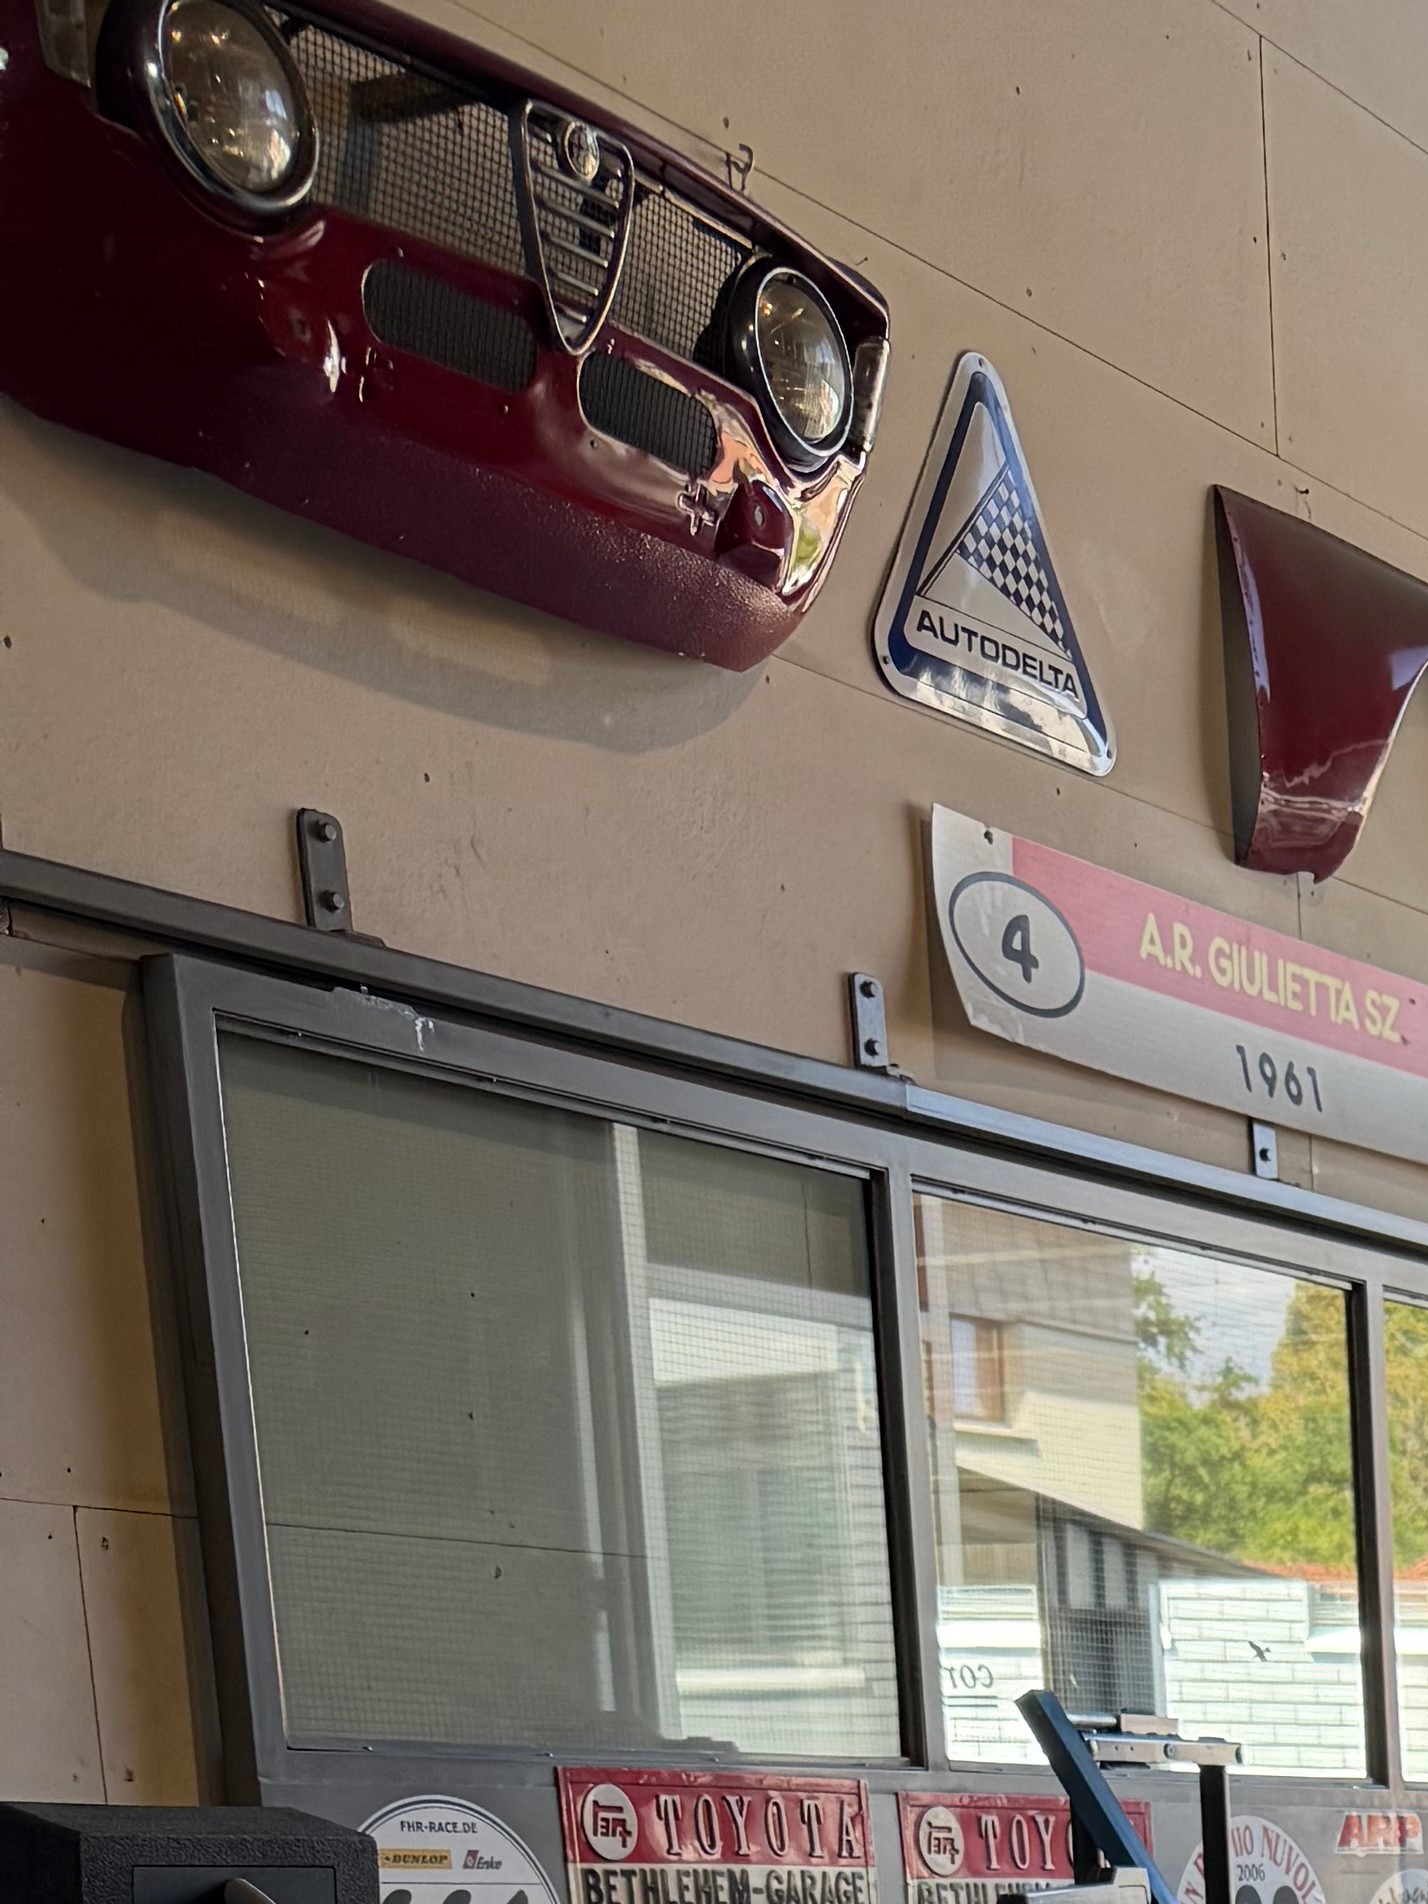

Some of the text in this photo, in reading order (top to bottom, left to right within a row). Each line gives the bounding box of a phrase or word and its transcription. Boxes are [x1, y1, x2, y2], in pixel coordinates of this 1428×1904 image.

[916, 608, 1079, 700] AUTODELTA
[1001, 914, 1040, 983] 4
[1139, 912, 1402, 1044] A.R. GIULIETTA SZ
[1234, 1044, 1325, 1113] 1961
[391, 1853, 449, 1865] DUNLOP
[400, 1820, 478, 1834] FHR-RACE.DE
[655, 1793, 863, 1860] TOYOTA
[979, 1812, 1073, 1871] TOY
[1236, 1863, 1266, 1882] 2006
